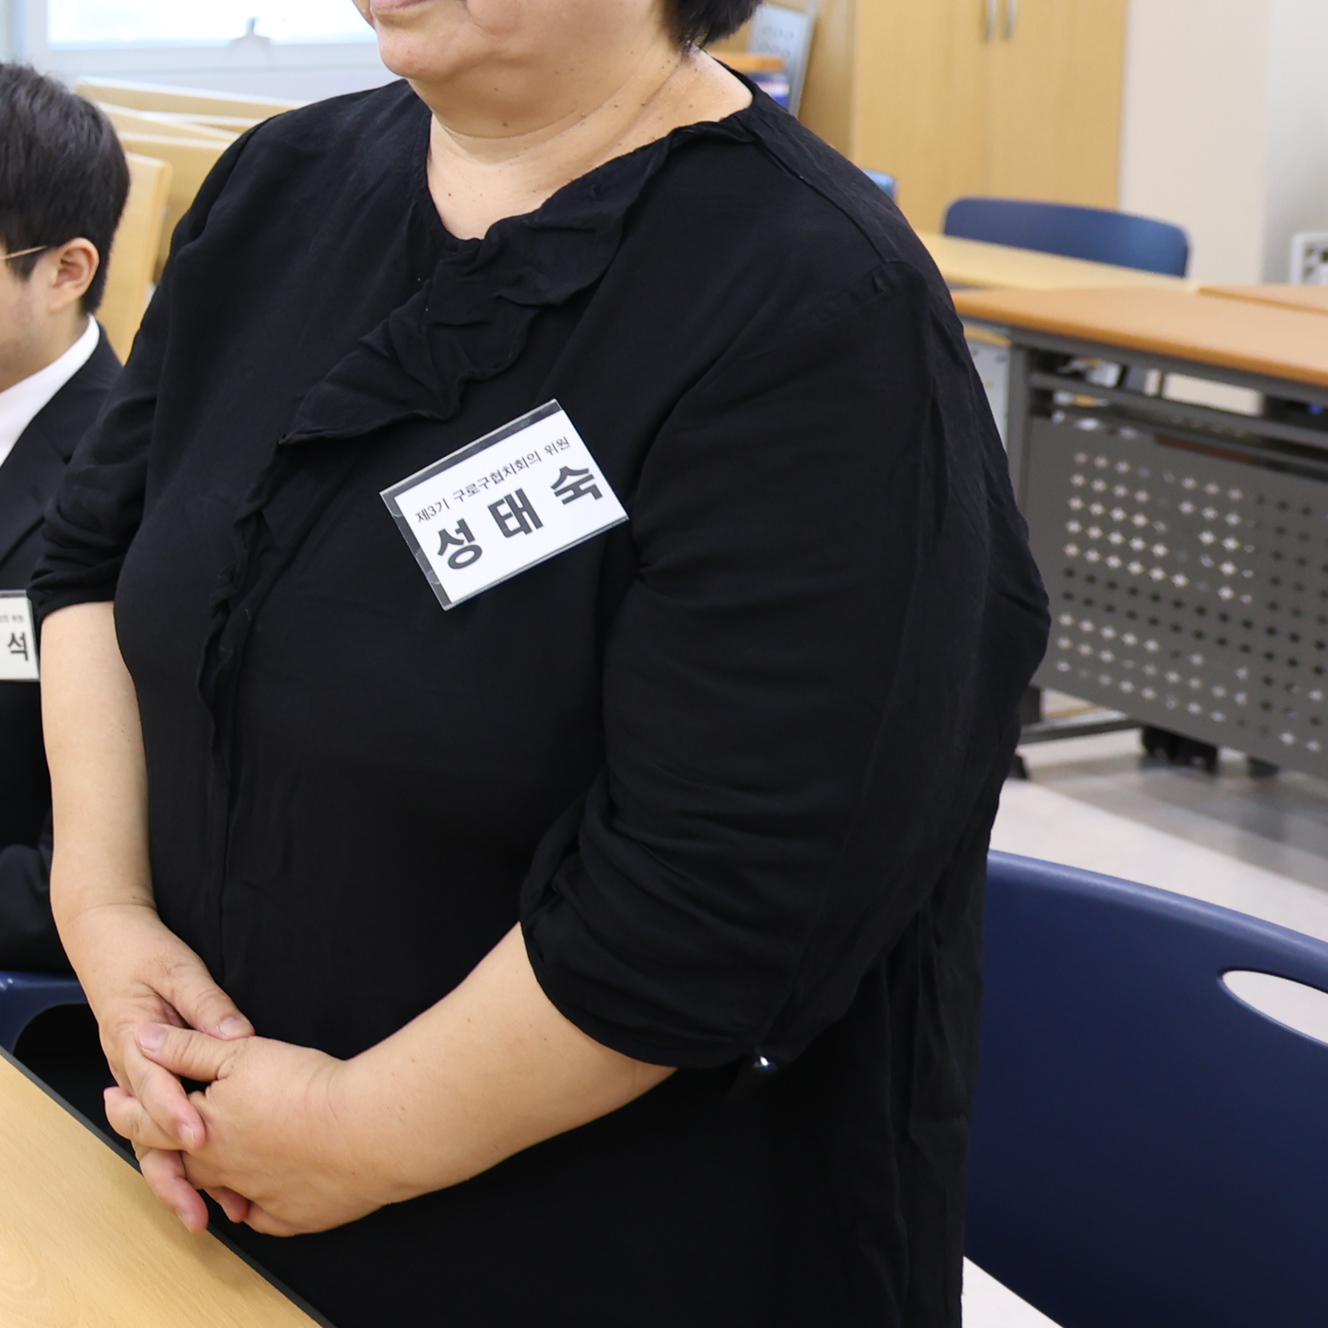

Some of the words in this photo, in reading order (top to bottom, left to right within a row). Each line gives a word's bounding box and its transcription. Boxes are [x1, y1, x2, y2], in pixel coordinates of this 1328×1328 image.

[415, 498, 451, 523] 제3기
[452, 450, 543, 504] 구로구협치회의
[544, 436, 572, 457] 위원
